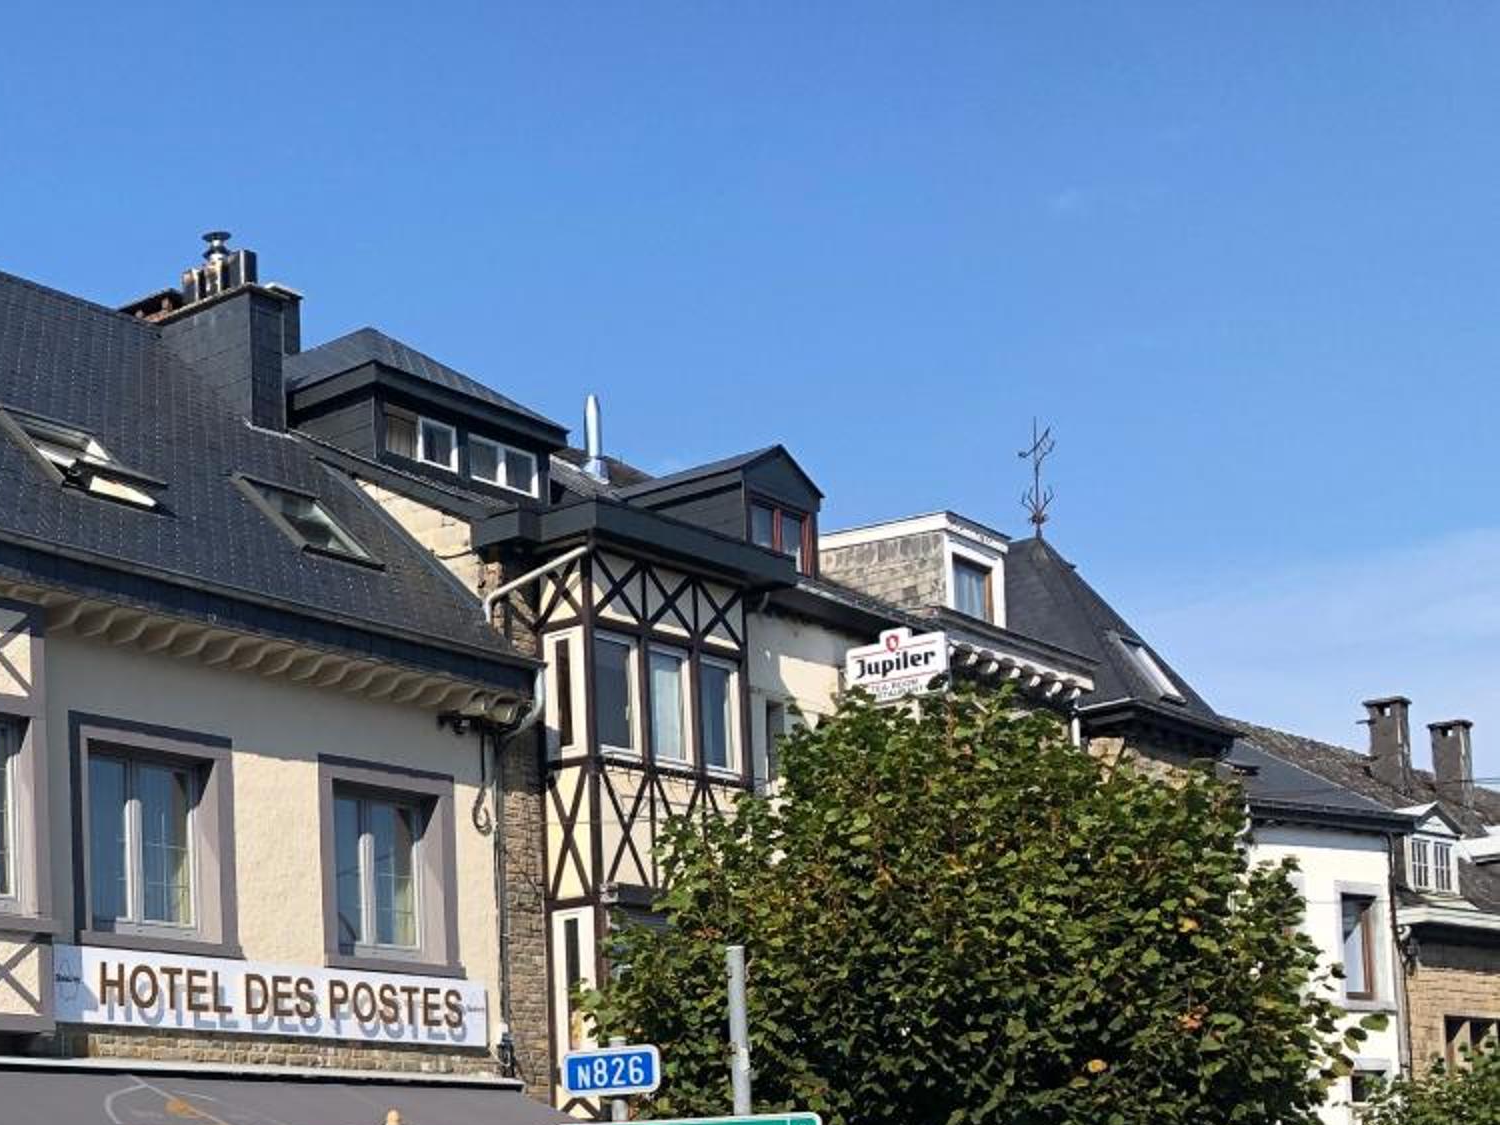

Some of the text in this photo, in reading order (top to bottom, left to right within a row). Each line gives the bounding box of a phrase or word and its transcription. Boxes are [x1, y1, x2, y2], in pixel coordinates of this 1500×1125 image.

[855, 650, 936, 679] Jupiler
[100, 961, 463, 1028] HOTEL DES POSTES
[577, 1056, 645, 1089] N826
